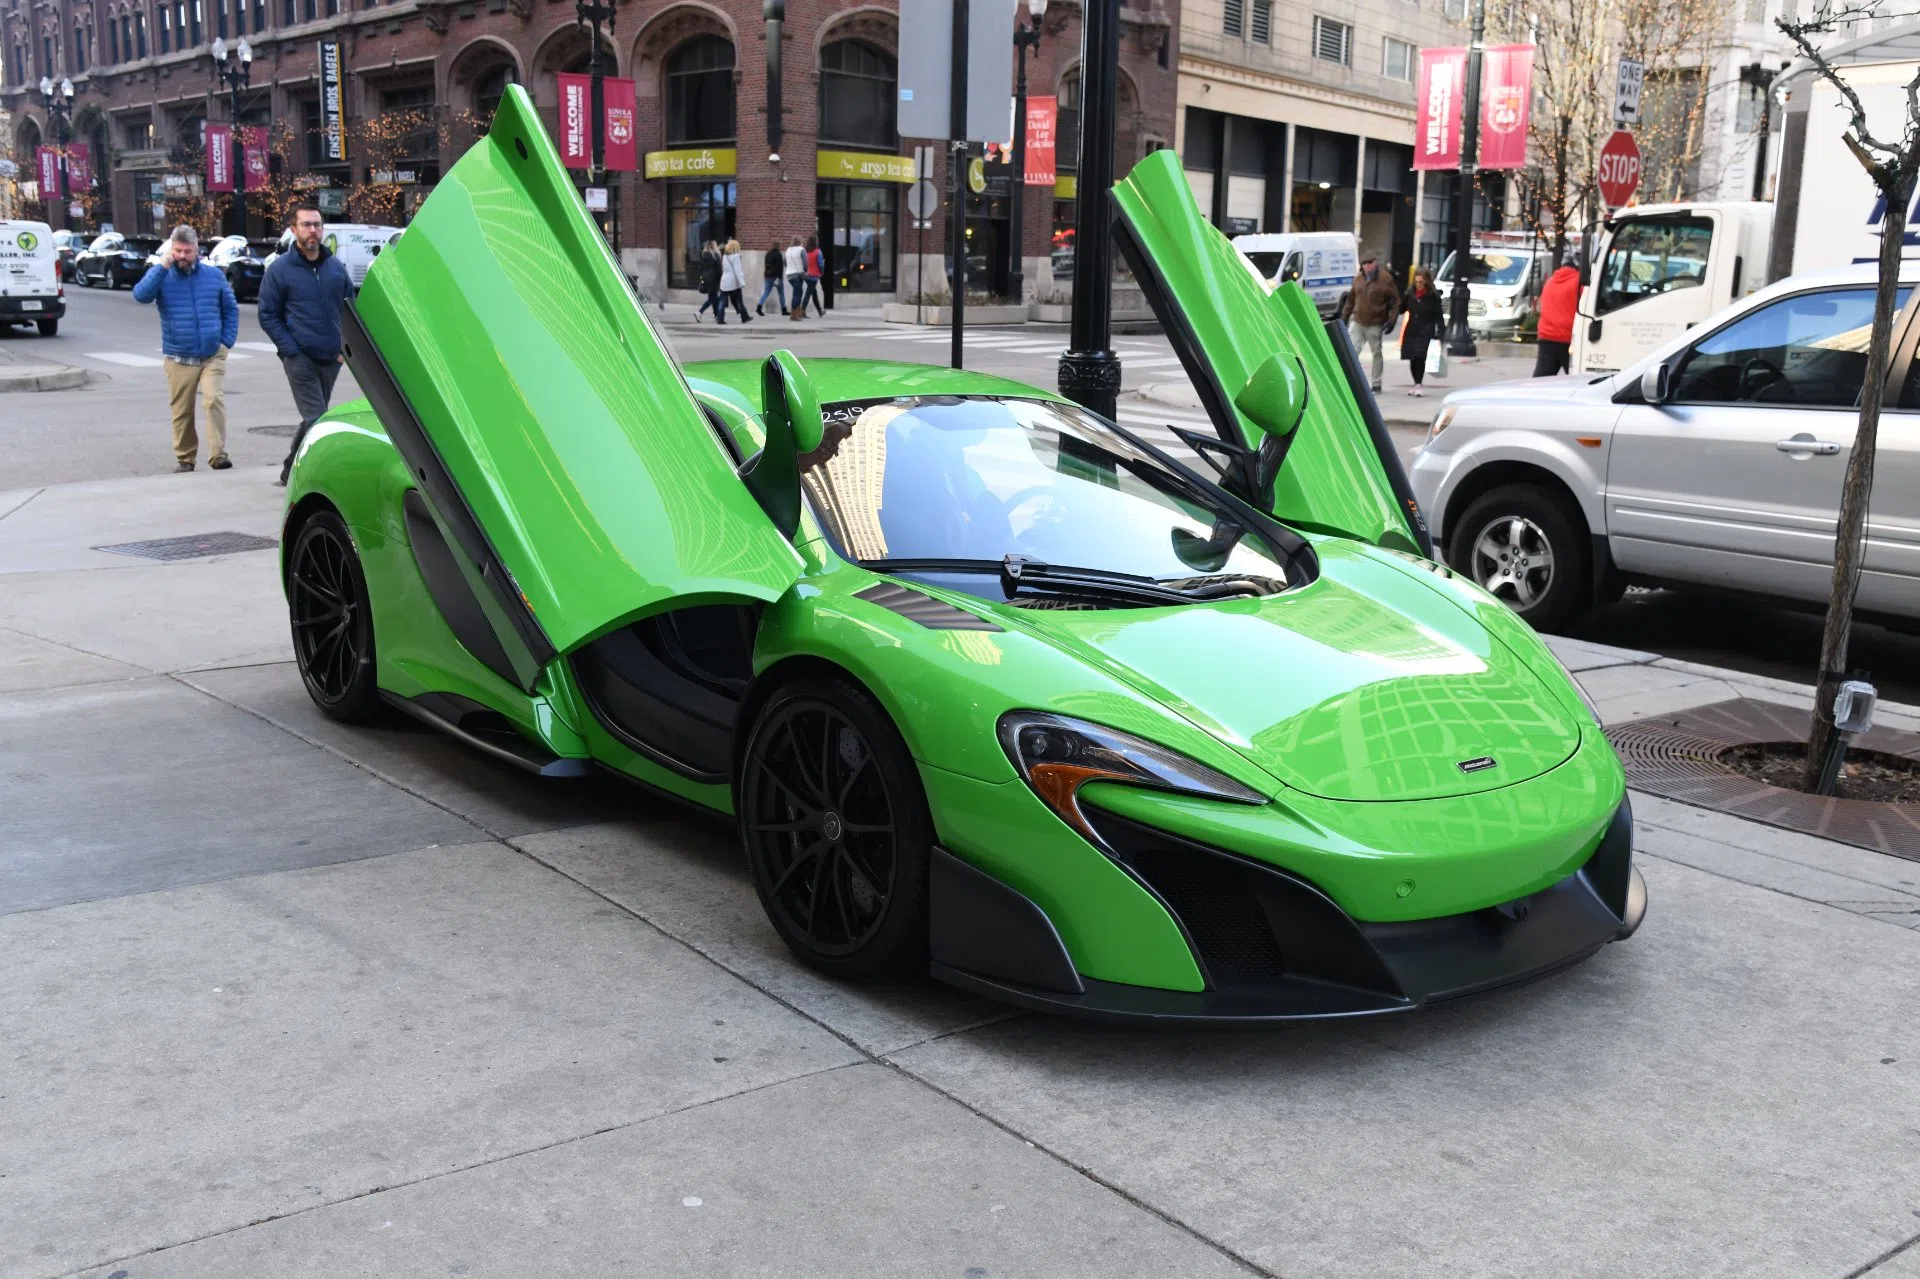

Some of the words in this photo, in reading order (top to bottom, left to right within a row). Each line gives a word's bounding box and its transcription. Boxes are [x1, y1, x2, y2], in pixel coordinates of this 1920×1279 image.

[325, 43, 338, 82] BAGELS
[1621, 63, 1641, 82] ONE
[1619, 82, 1639, 98] WAY
[567, 85, 579, 157] WELCOME
[1426, 64, 1447, 155] WELCO
[329, 114, 341, 159] EINSTEIN
[212, 134, 222, 184] WELCOME
[686, 149, 715, 170] café
[860, 162, 886, 179] argo
[1600, 154, 1638, 184] STOP
[1586, 354, 1607, 365] 432
